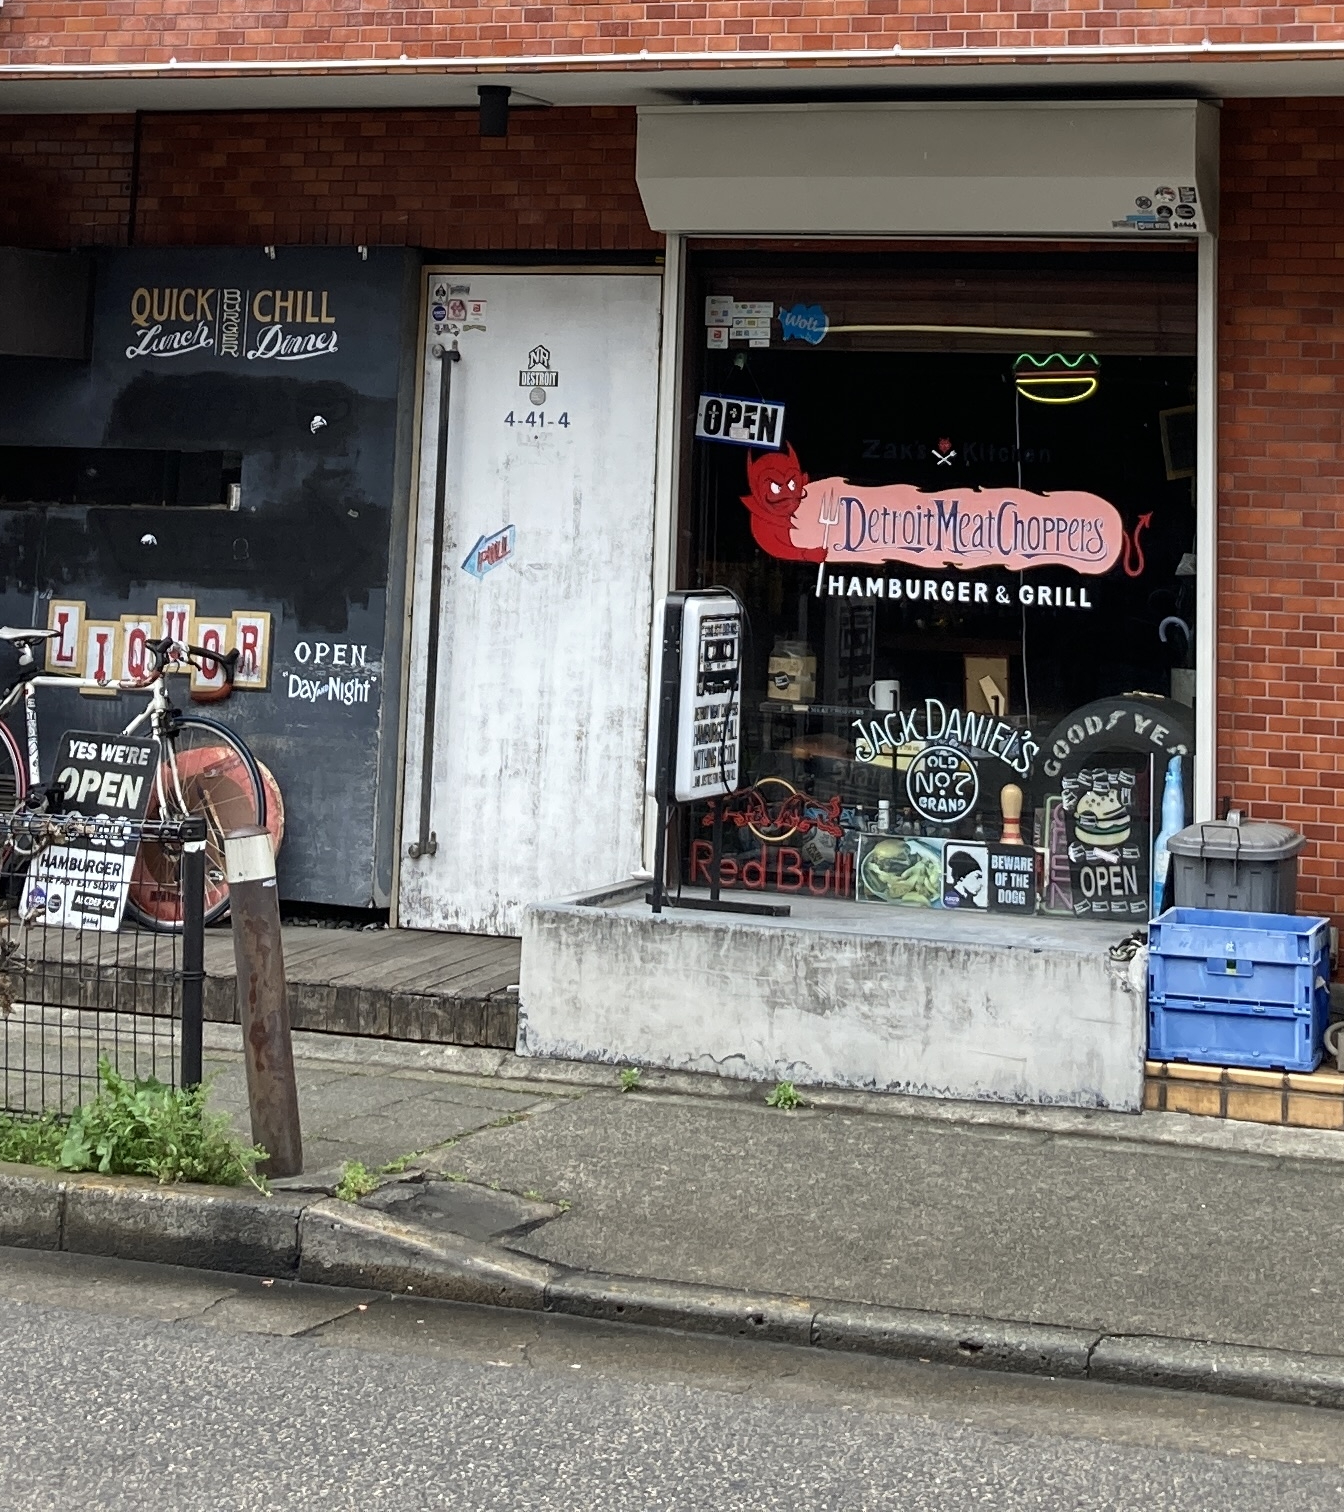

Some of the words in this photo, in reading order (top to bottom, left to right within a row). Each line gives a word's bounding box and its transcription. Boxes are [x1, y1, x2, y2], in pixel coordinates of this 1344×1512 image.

[131, 288, 215, 327] QUICK
[253, 290, 336, 324] CHILL
[785, 312, 819, 332] Wolt
[125, 320, 214, 359] Lunch
[247, 324, 339, 360] Dinner
[703, 399, 778, 443] OPEN
[828, 576, 988, 603] HAMBURGER
[995, 585, 1010, 604] &
[1019, 585, 1092, 608] GRILL
[294, 642, 367, 667] OPEN
[852, 708, 923, 763] JACK
[925, 699, 1039, 773] DANIEL'S
[69, 740, 97, 761] YES
[101, 743, 150, 765] WE'RE
[927, 755, 959, 769] OLD
[57, 767, 144, 810] OPEN
[919, 797, 967, 813] BRAND
[40, 854, 122, 877] HAMBURGER
[690, 840, 767, 887] Red
[777, 847, 854, 897] Bull
[991, 855, 1033, 872] BEWARE
[995, 872, 1008, 887] OF
[1010, 873, 1029, 888] THE
[1080, 865, 1139, 898] OPEN
[997, 889, 1026, 905] DOGG
